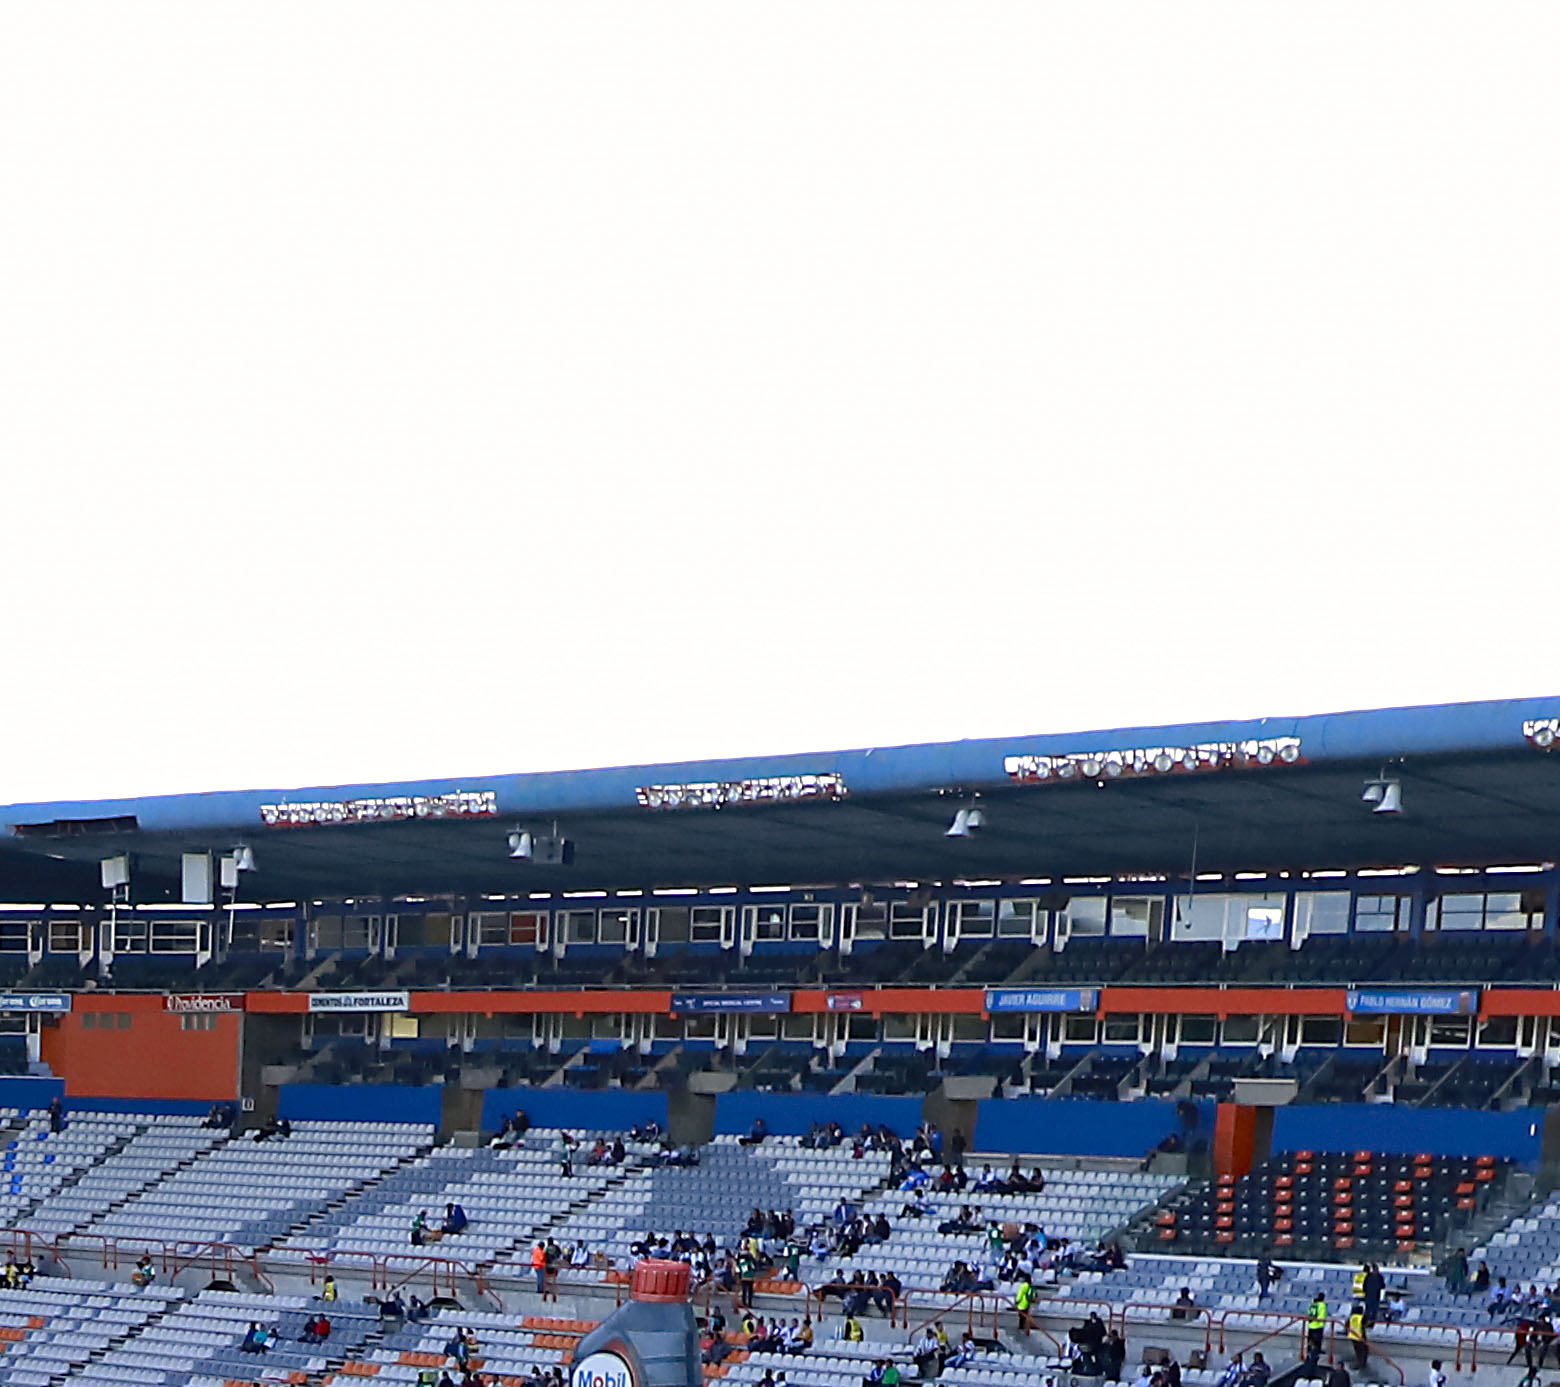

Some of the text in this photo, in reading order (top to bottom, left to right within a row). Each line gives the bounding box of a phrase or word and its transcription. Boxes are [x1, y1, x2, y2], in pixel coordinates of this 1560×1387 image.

[174, 995, 230, 1011] Providencia
[354, 997, 404, 1007] FORTALEZA
[999, 993, 1066, 1006] JAVIER AGUIRRE
[1360, 995, 1384, 1007] PABLO
